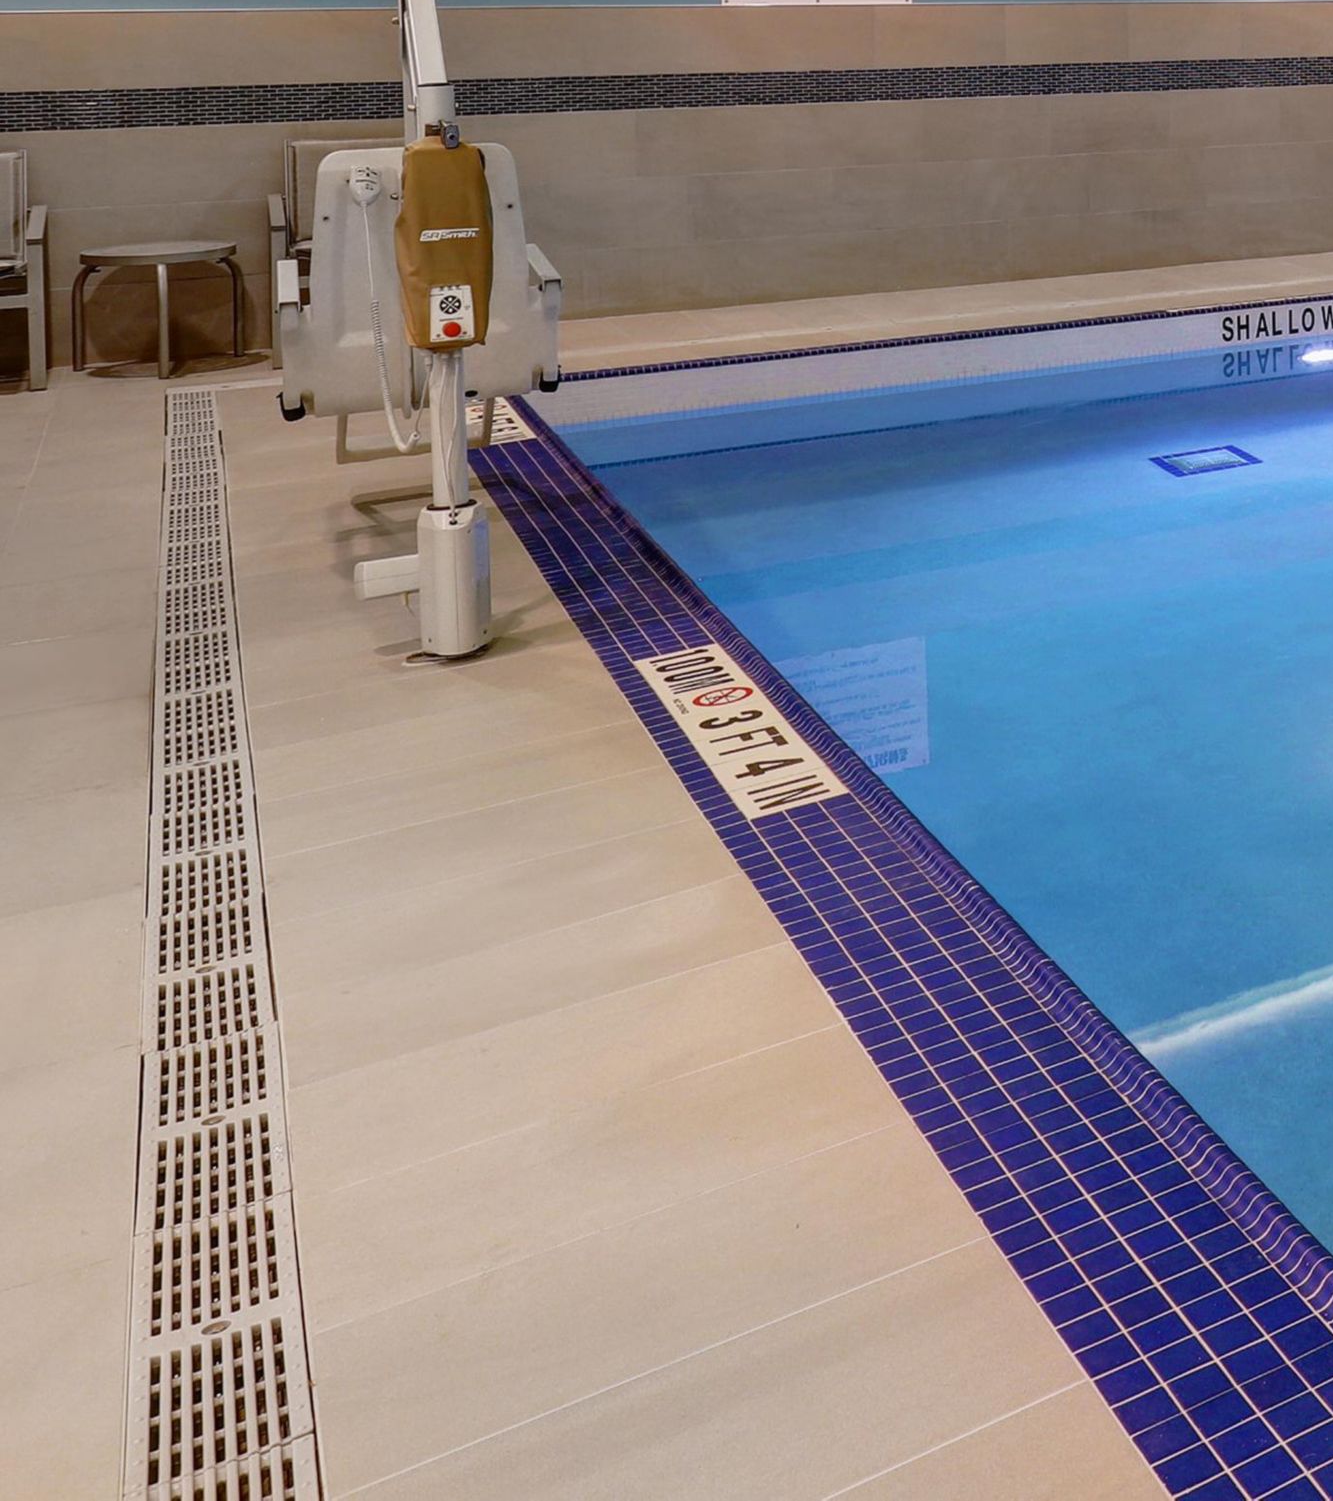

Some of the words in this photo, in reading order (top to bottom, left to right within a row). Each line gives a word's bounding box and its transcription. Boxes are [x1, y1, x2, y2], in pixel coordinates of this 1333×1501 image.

[649, 648, 735, 695] 1.00M
[699, 709, 764, 730] 3
[709, 726, 789, 757] FT
[735, 757, 804, 779] 4
[747, 774, 831, 811] IN
